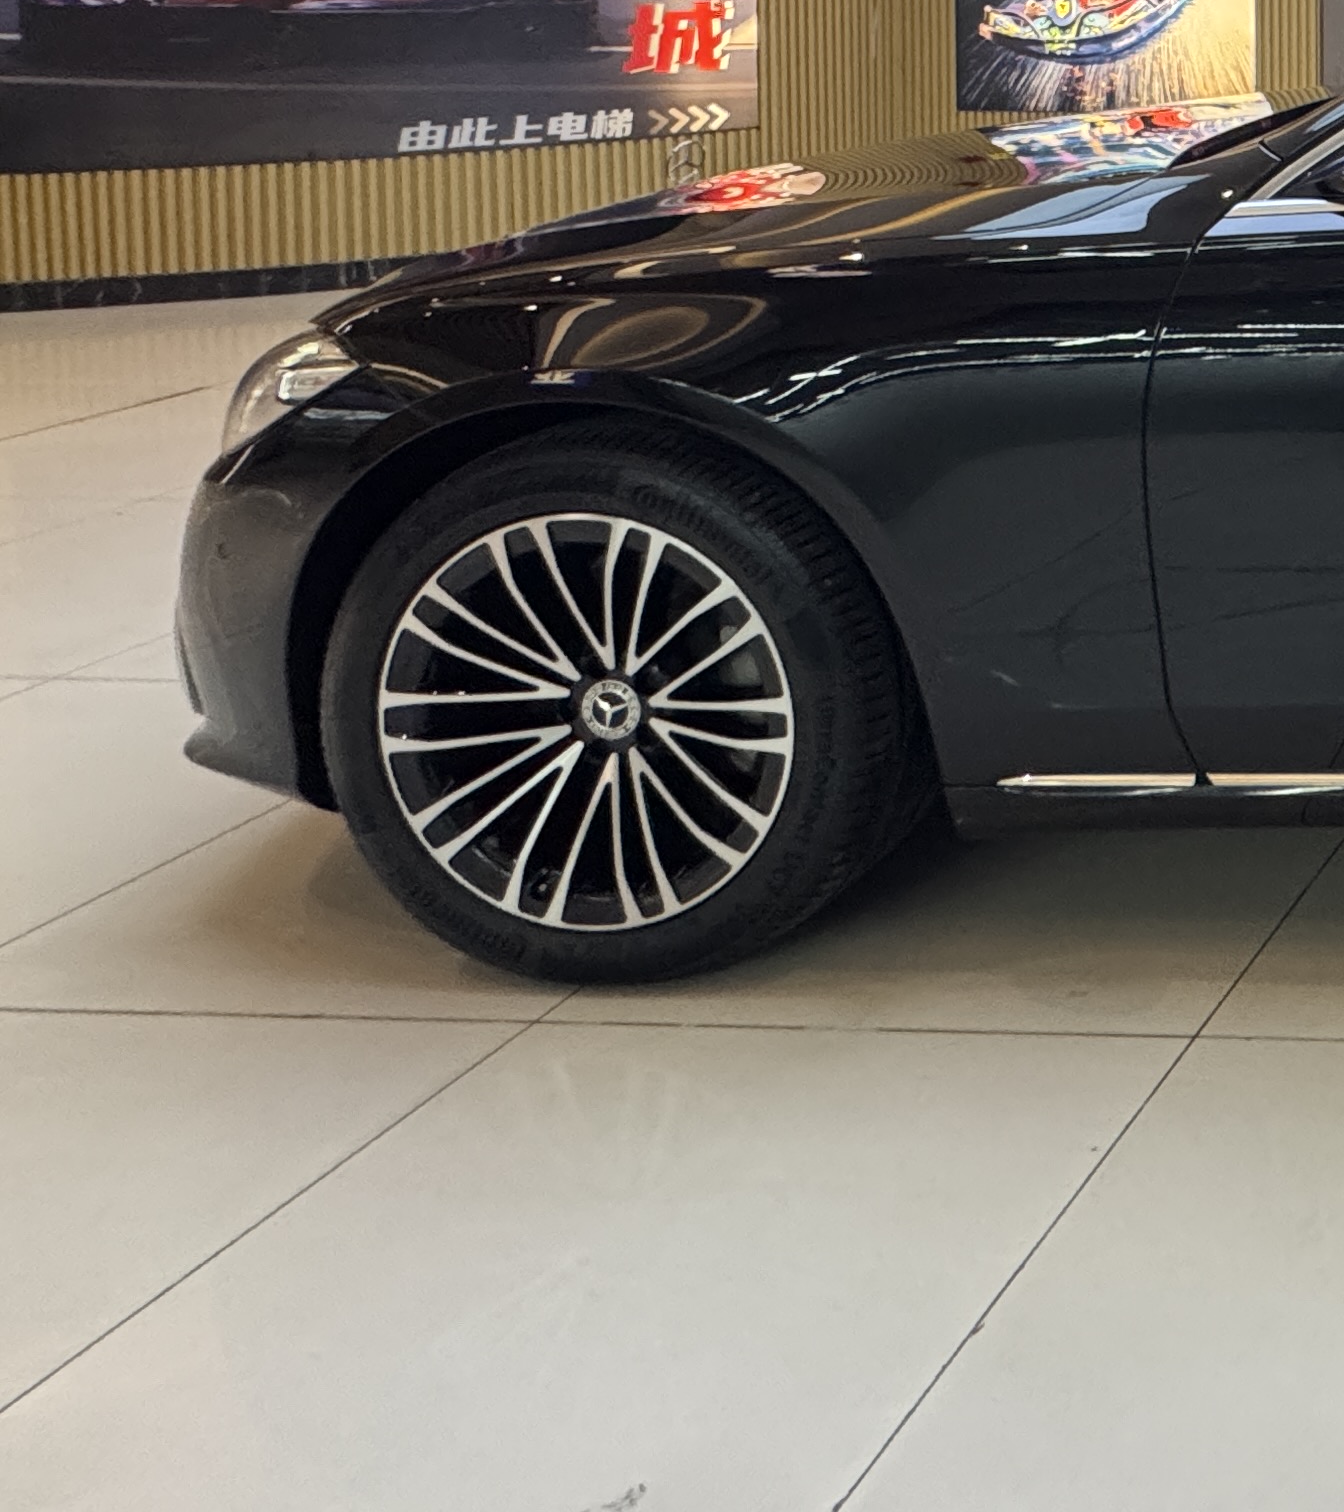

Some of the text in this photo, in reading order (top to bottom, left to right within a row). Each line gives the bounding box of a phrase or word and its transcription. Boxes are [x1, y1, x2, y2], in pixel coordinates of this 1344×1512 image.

[397, 107, 634, 153] 由此上电梯
